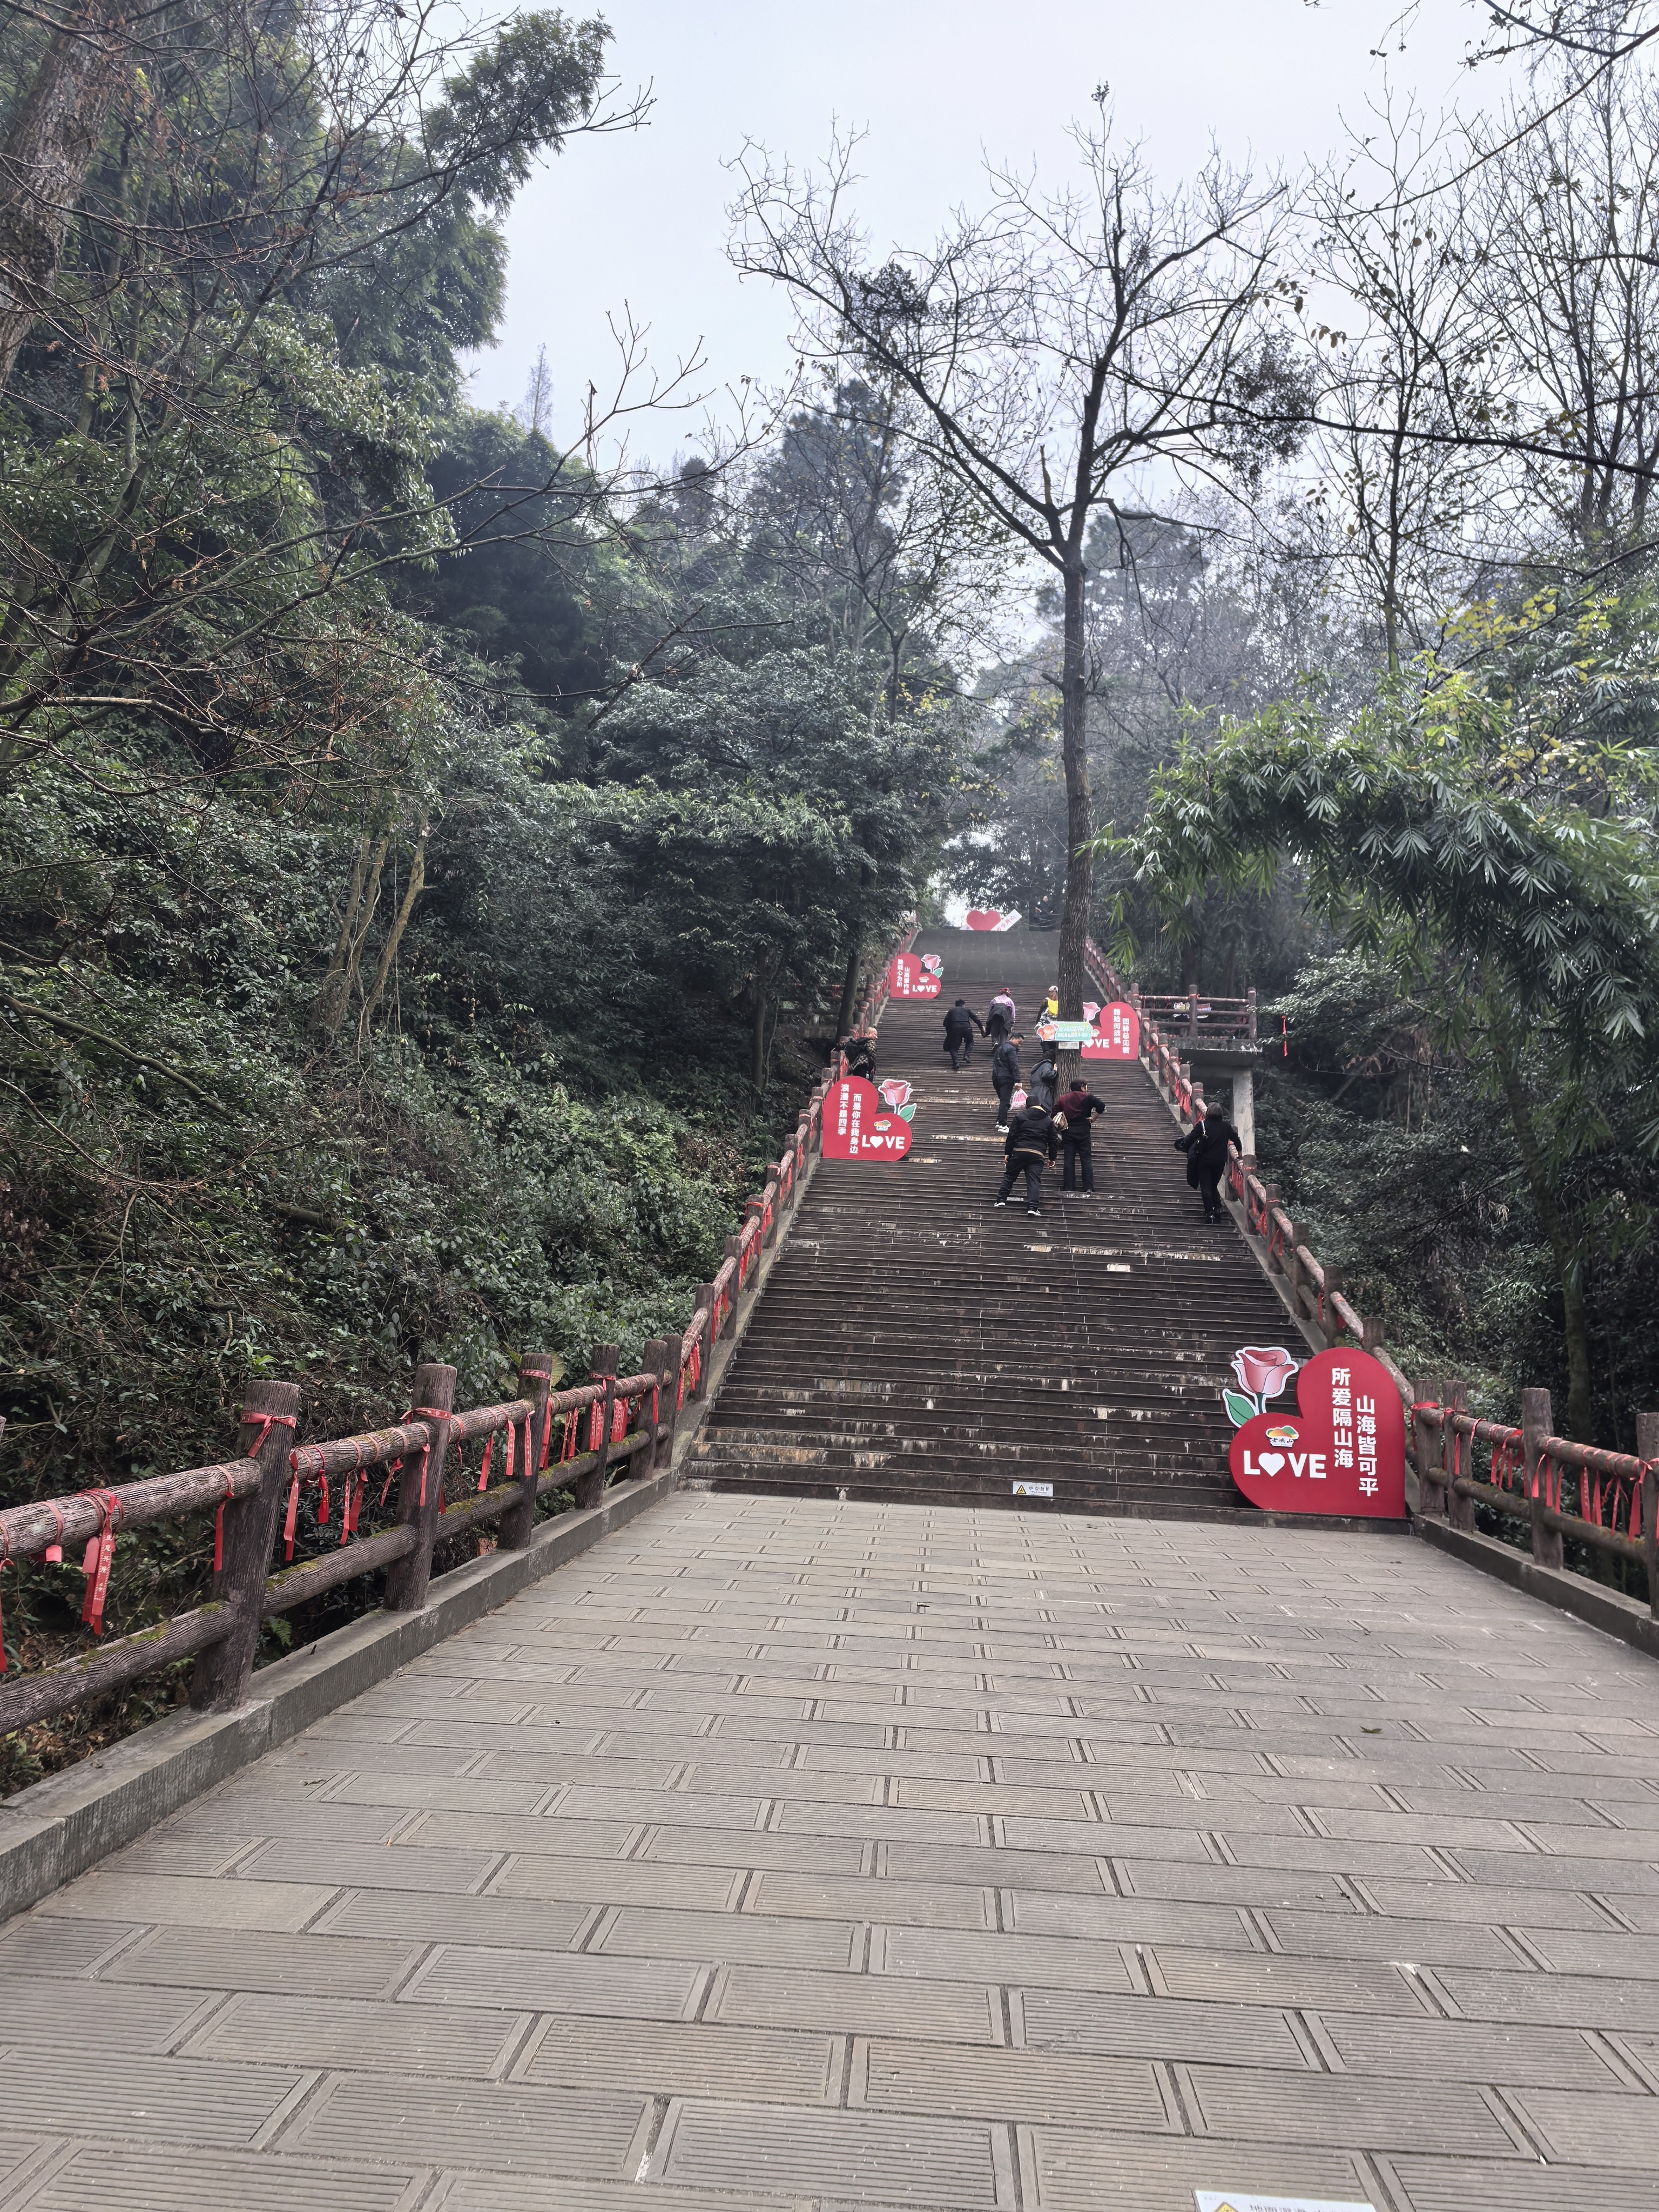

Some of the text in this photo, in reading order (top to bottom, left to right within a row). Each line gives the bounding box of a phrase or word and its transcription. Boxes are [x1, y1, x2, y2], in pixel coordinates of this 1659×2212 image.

[838, 1084, 849, 1135] 浪漫不是四季
[849, 1094, 861, 1154] 而是你在我身边
[1332, 1368, 1353, 1467] 所爱隔山海
[1357, 1395, 1378, 1496] 山海皆可平
